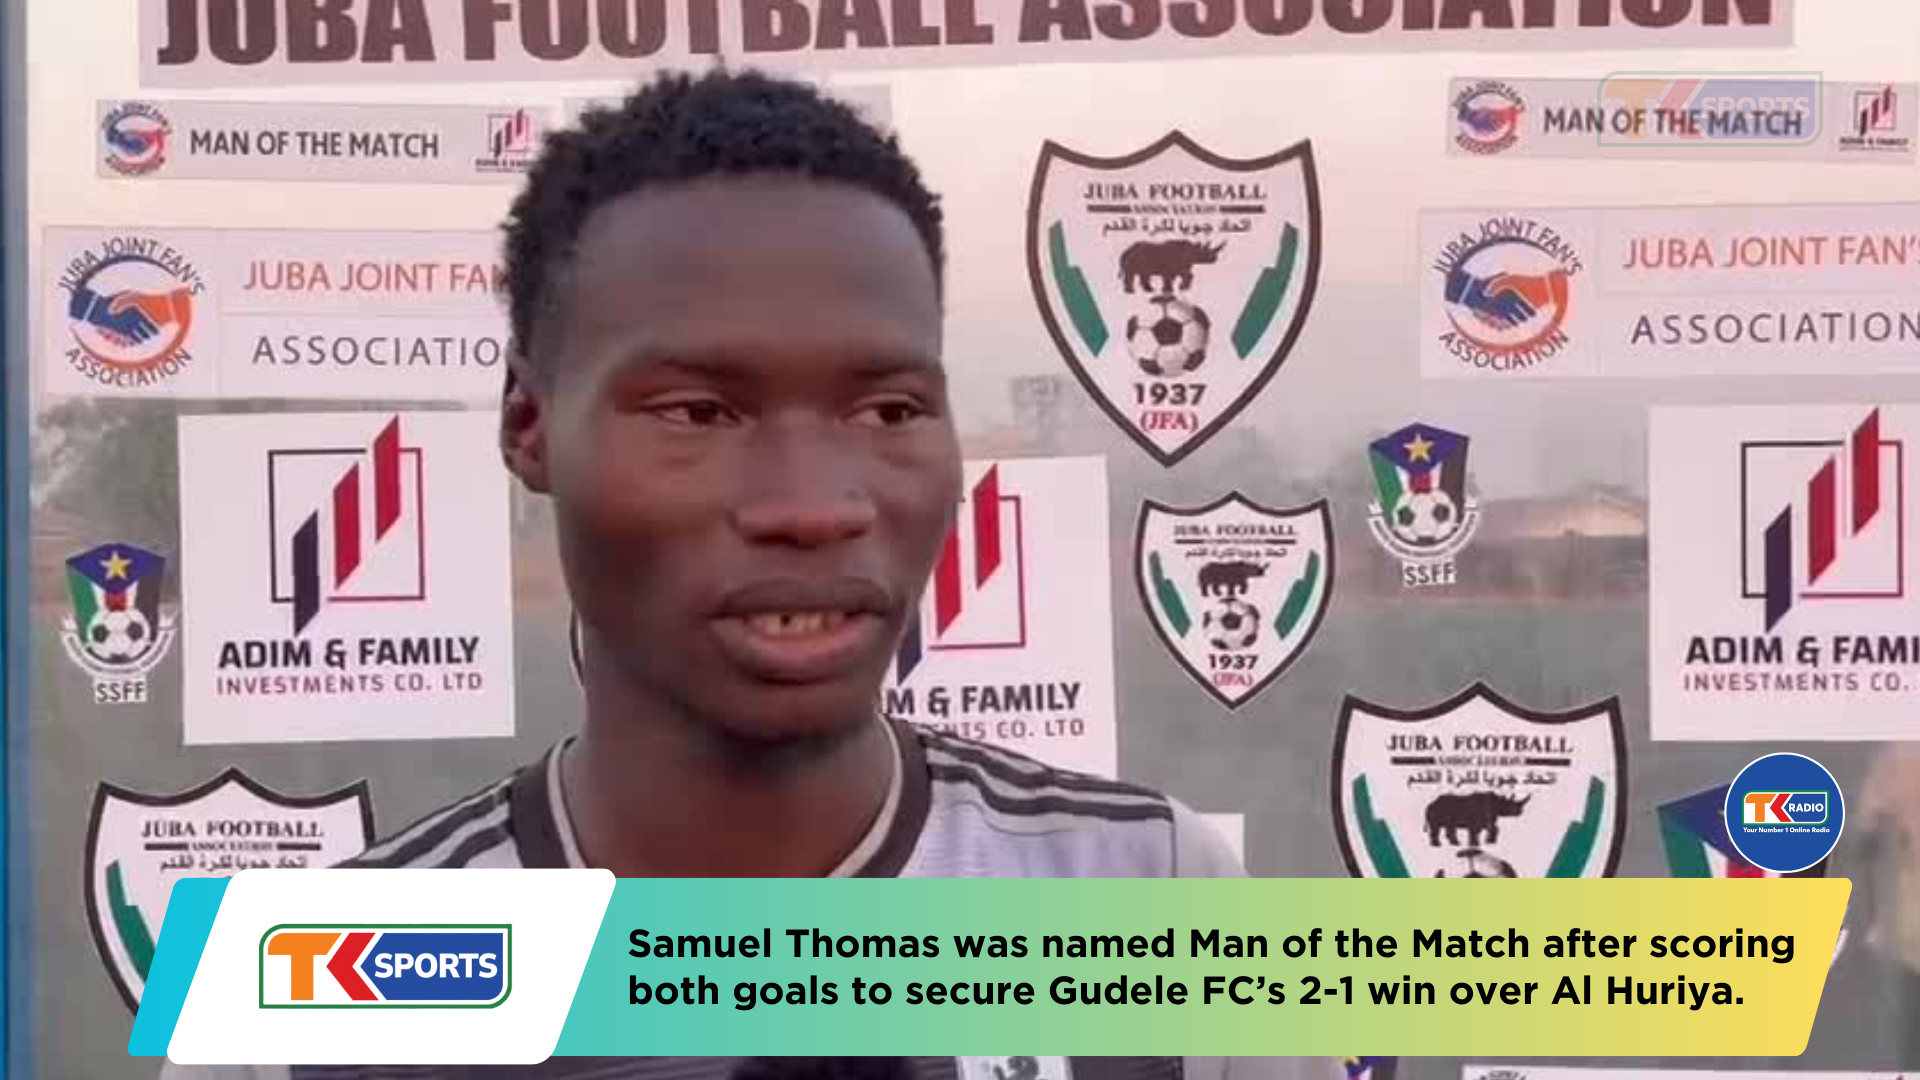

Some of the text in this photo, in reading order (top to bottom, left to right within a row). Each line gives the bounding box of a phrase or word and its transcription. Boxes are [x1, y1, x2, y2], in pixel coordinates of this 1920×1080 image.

[158, 0, 436, 65] JUBA
[1544, 107, 1802, 136] MAN OF THE MATCH
[190, 129, 439, 158] MAN OF THE MATCH
[1083, 183, 1267, 199] JUBA FOOTBALL
[1433, 217, 1584, 276] JUBA JOINT FAN'S
[1622, 235, 1920, 269] JUBA JOINT FAN'
[58, 237, 206, 296] JUBA JOINT FAN'S
[243, 261, 509, 293] JUBA JOINT FAN
[1631, 312, 1920, 344] ASSOCIATION
[252, 336, 500, 366] ASSOCIATIO
[1439, 327, 1569, 370] ASSOCIATION
[65, 347, 193, 387] ASSOCIATION
[1134, 382, 1207, 405] 1937
[1140, 410, 1199, 433] (JFA)
[1405, 562, 1454, 585] SSFF
[218, 637, 479, 670] ADIM & FAMILY
[1208, 653, 1259, 670] 1937
[1685, 635, 1920, 668] ADIM & FAMI
[97, 682, 145, 702] SSFF
[216, 672, 483, 695] INVESTMENTS CO. LTD
[1684, 672, 1909, 691] INVESTMENTS CO.
[928, 686, 951, 717] &
[962, 682, 1080, 714] FAMILY
[996, 720, 1034, 739] CO.
[1045, 718, 1085, 737] LTD
[1387, 735, 1574, 753] JUBA FOOTBALL
[141, 820, 324, 837] JUBA FOOTBALL
